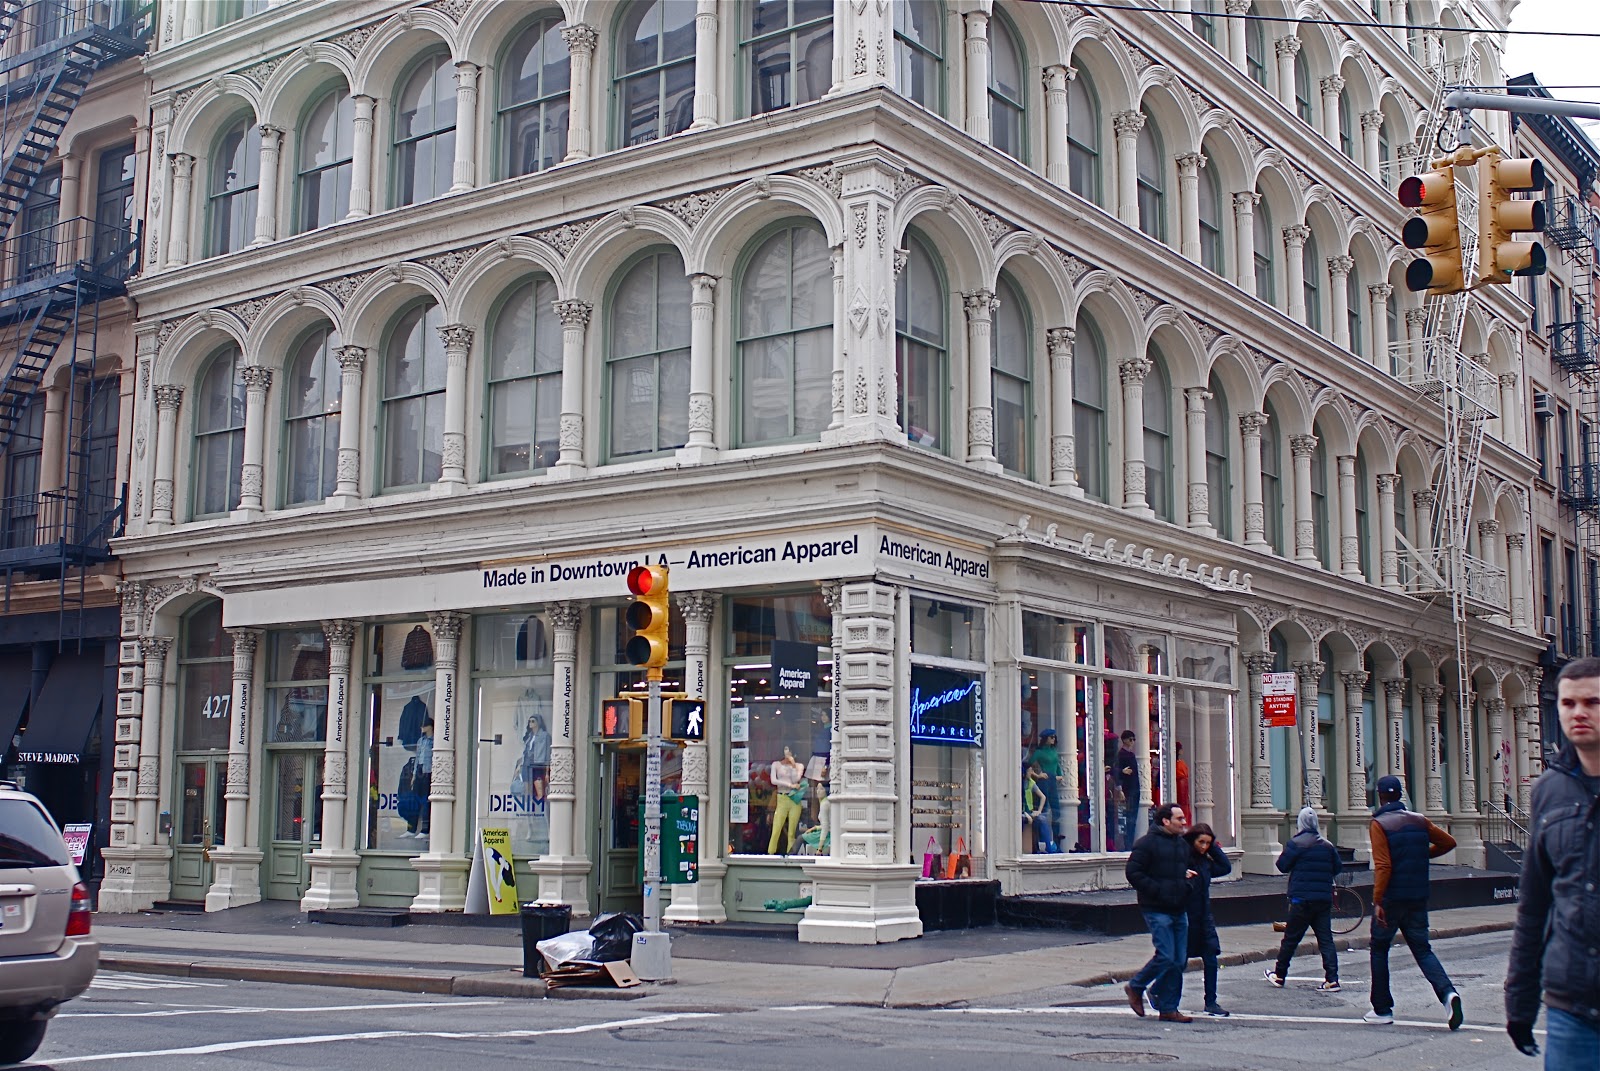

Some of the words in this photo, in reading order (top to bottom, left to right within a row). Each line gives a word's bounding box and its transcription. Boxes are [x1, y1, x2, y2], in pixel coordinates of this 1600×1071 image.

[483, 568, 526, 588] Made
[531, 566, 545, 584] in
[550, 560, 638, 582] Downtown
[781, 534, 858, 562] Apparel
[879, 534, 942, 567] American
[944, 549, 990, 578] Apparel
[779, 667, 811, 680] American
[1263, 674, 1272, 682] NO
[444, 673, 452, 704] Apparel
[564, 666, 572, 698] Apparel
[779, 678, 806, 689] Apparel
[202, 694, 230, 718] 427
[974, 680, 984, 747] Apparel
[562, 700, 570, 738] American
[911, 724, 973, 738] APPAREL
[18, 752, 42, 762] STEVE
[44, 753, 80, 764] MADDEN
[490, 794, 545, 812] DENIM
[482, 828, 508, 837] American
[484, 836, 505, 844] Apparel
[66, 842, 84, 850] EEK
